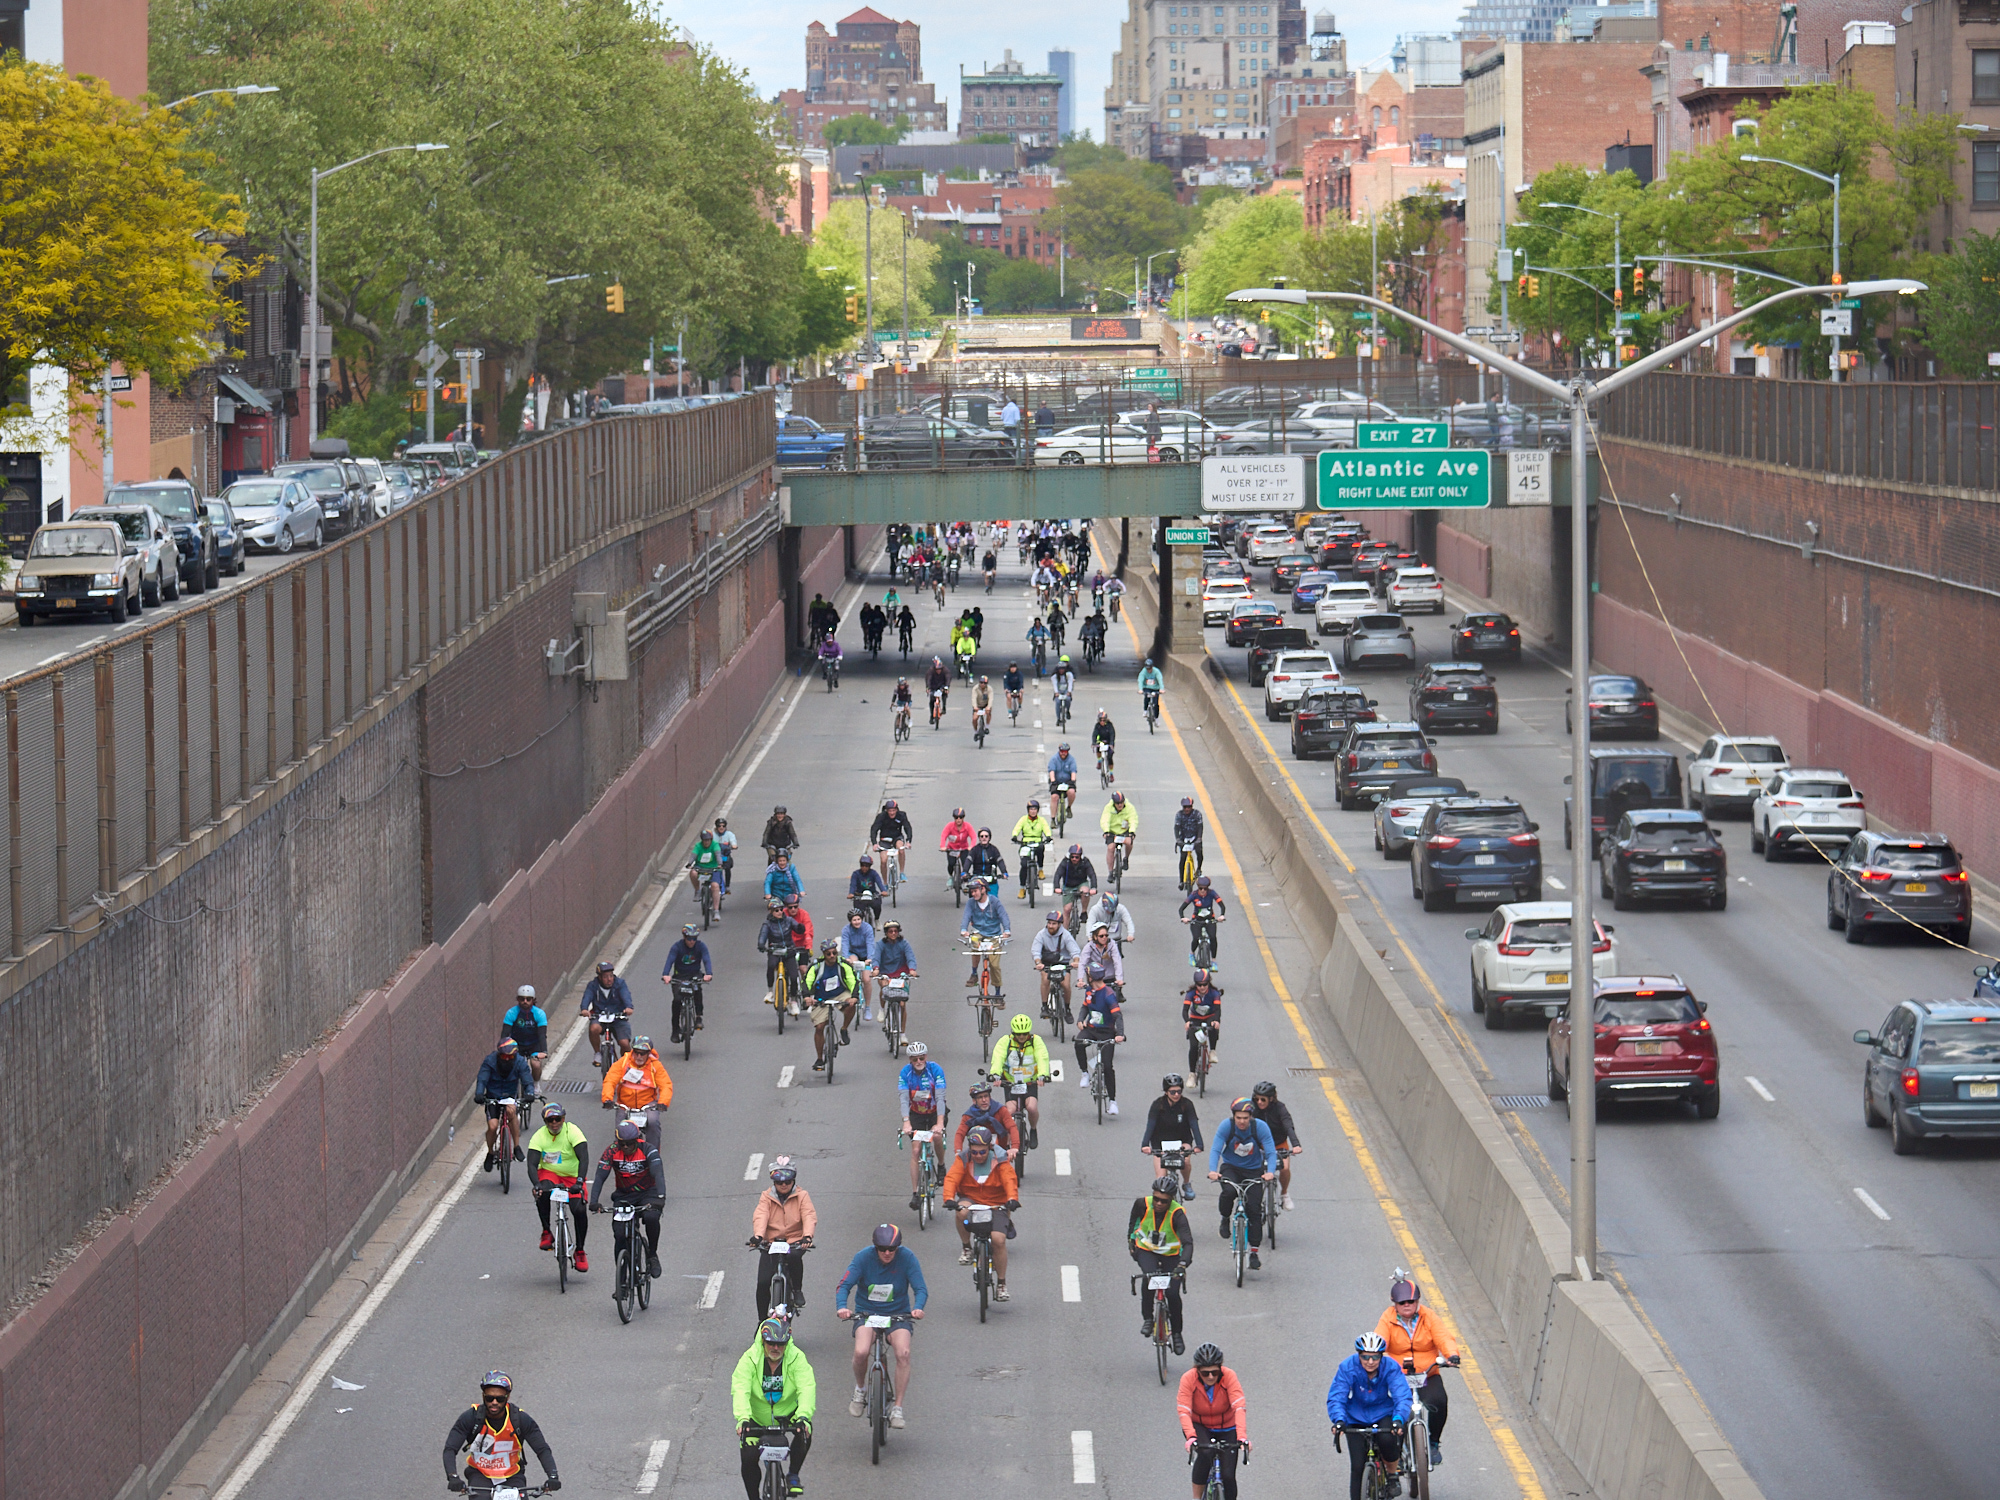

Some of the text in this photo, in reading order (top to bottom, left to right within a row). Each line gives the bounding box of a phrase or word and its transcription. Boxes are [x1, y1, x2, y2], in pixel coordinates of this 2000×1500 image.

[1370, 428, 1437, 443] EXIT 27
[1514, 453, 1544, 462] SPEED
[1220, 464, 1286, 473] ALL VEHICLES
[1330, 460, 1479, 476] Atlantic Ave
[1518, 464, 1540, 472] LIMIT
[1227, 479, 1251, 487] OVER
[1519, 476, 1540, 490] 45
[1338, 486, 1468, 498] RIGHT LANE EXIT ONLY
[1212, 494, 1236, 502] MUST
[1240, 494, 1257, 502] USE
[1282, 493, 1294, 501] 27
[1168, 532, 1207, 540] UNION ST
[479, 1456, 504, 1464] COURSE
